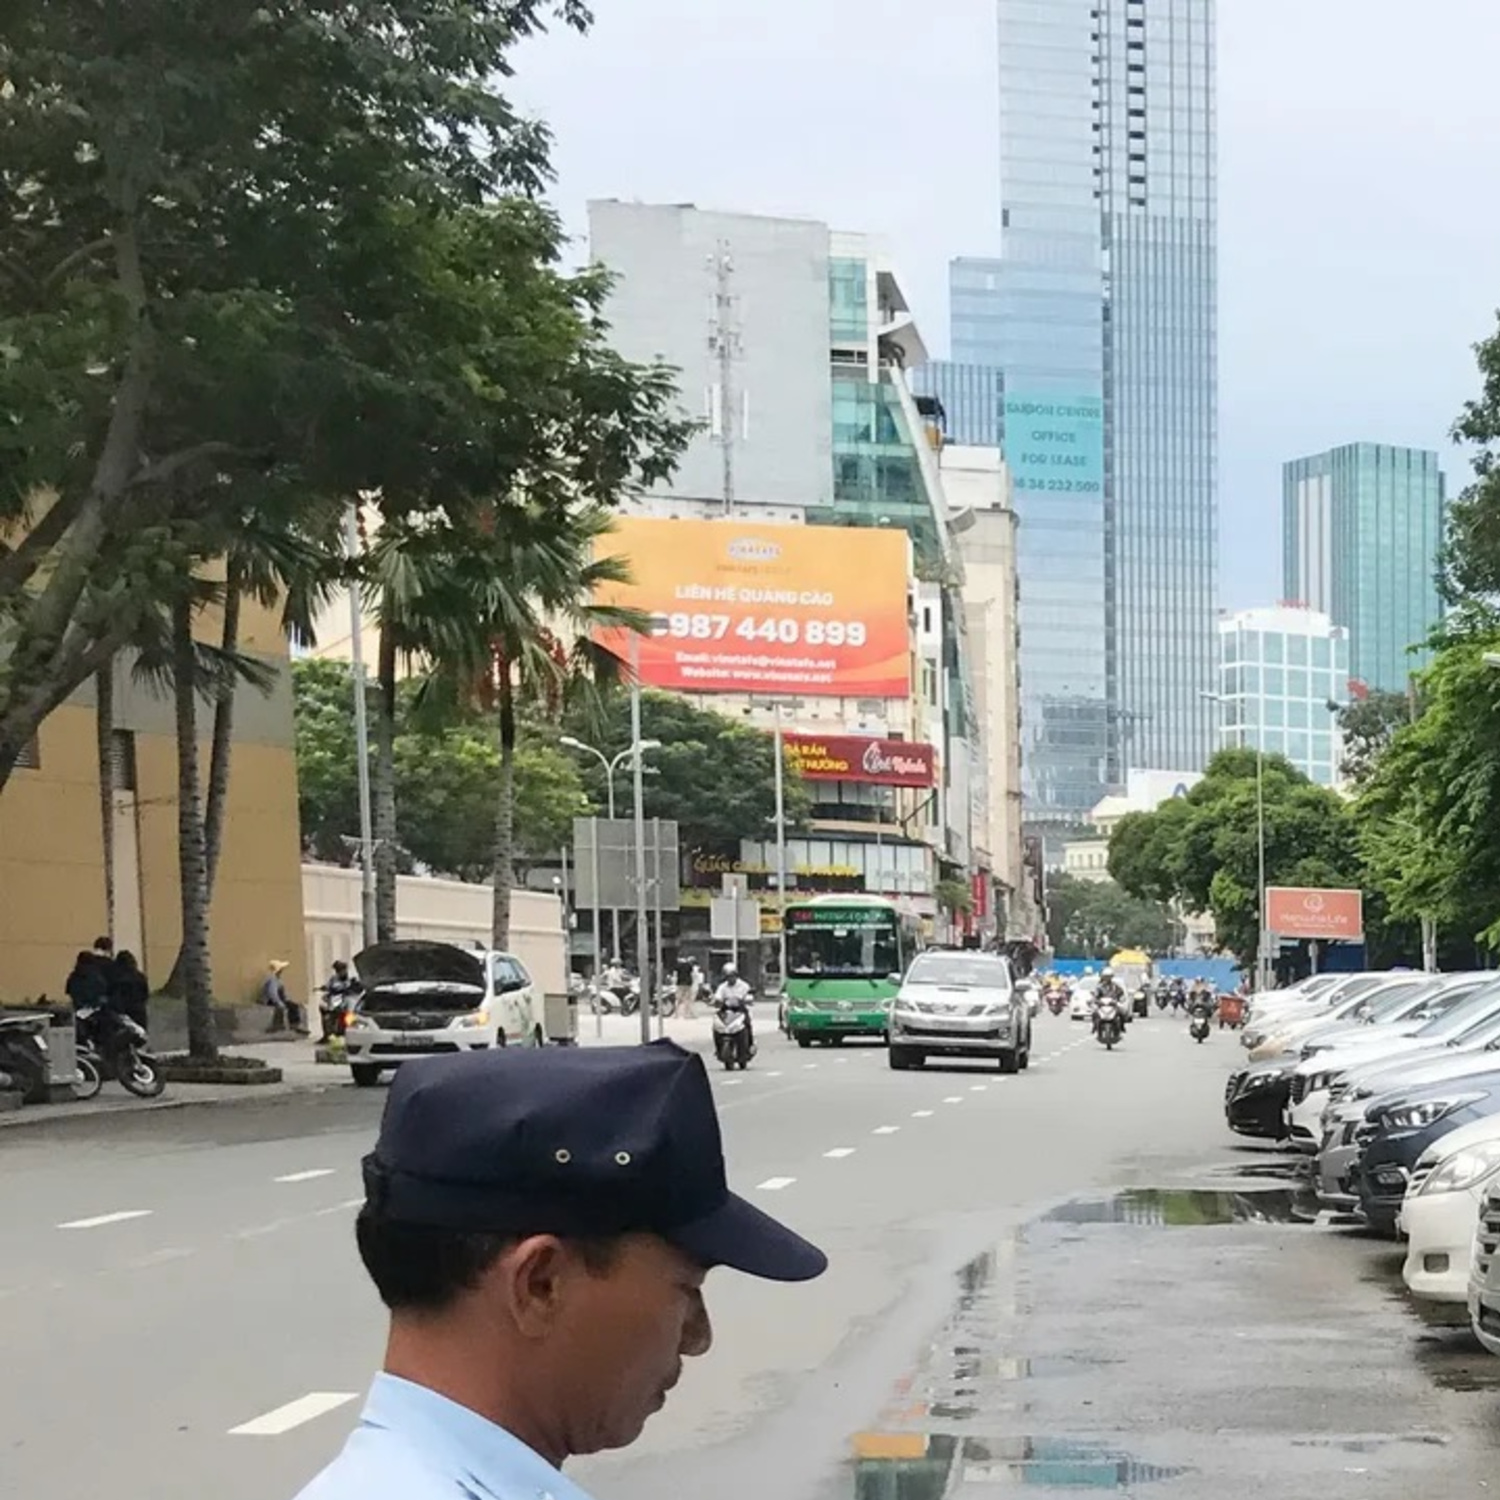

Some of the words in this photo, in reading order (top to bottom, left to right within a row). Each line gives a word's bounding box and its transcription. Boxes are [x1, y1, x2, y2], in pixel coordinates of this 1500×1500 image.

[1006, 402, 1054, 416] SAIGON
[1032, 430, 1076, 442] OFFICE
[1021, 452, 1047, 465] FOR
[1051, 453, 1087, 467] LEASE
[675, 583, 712, 600] LIÊN
[735, 616, 799, 643] 440
[804, 620, 867, 646] 899
[675, 651, 711, 664] Email:
